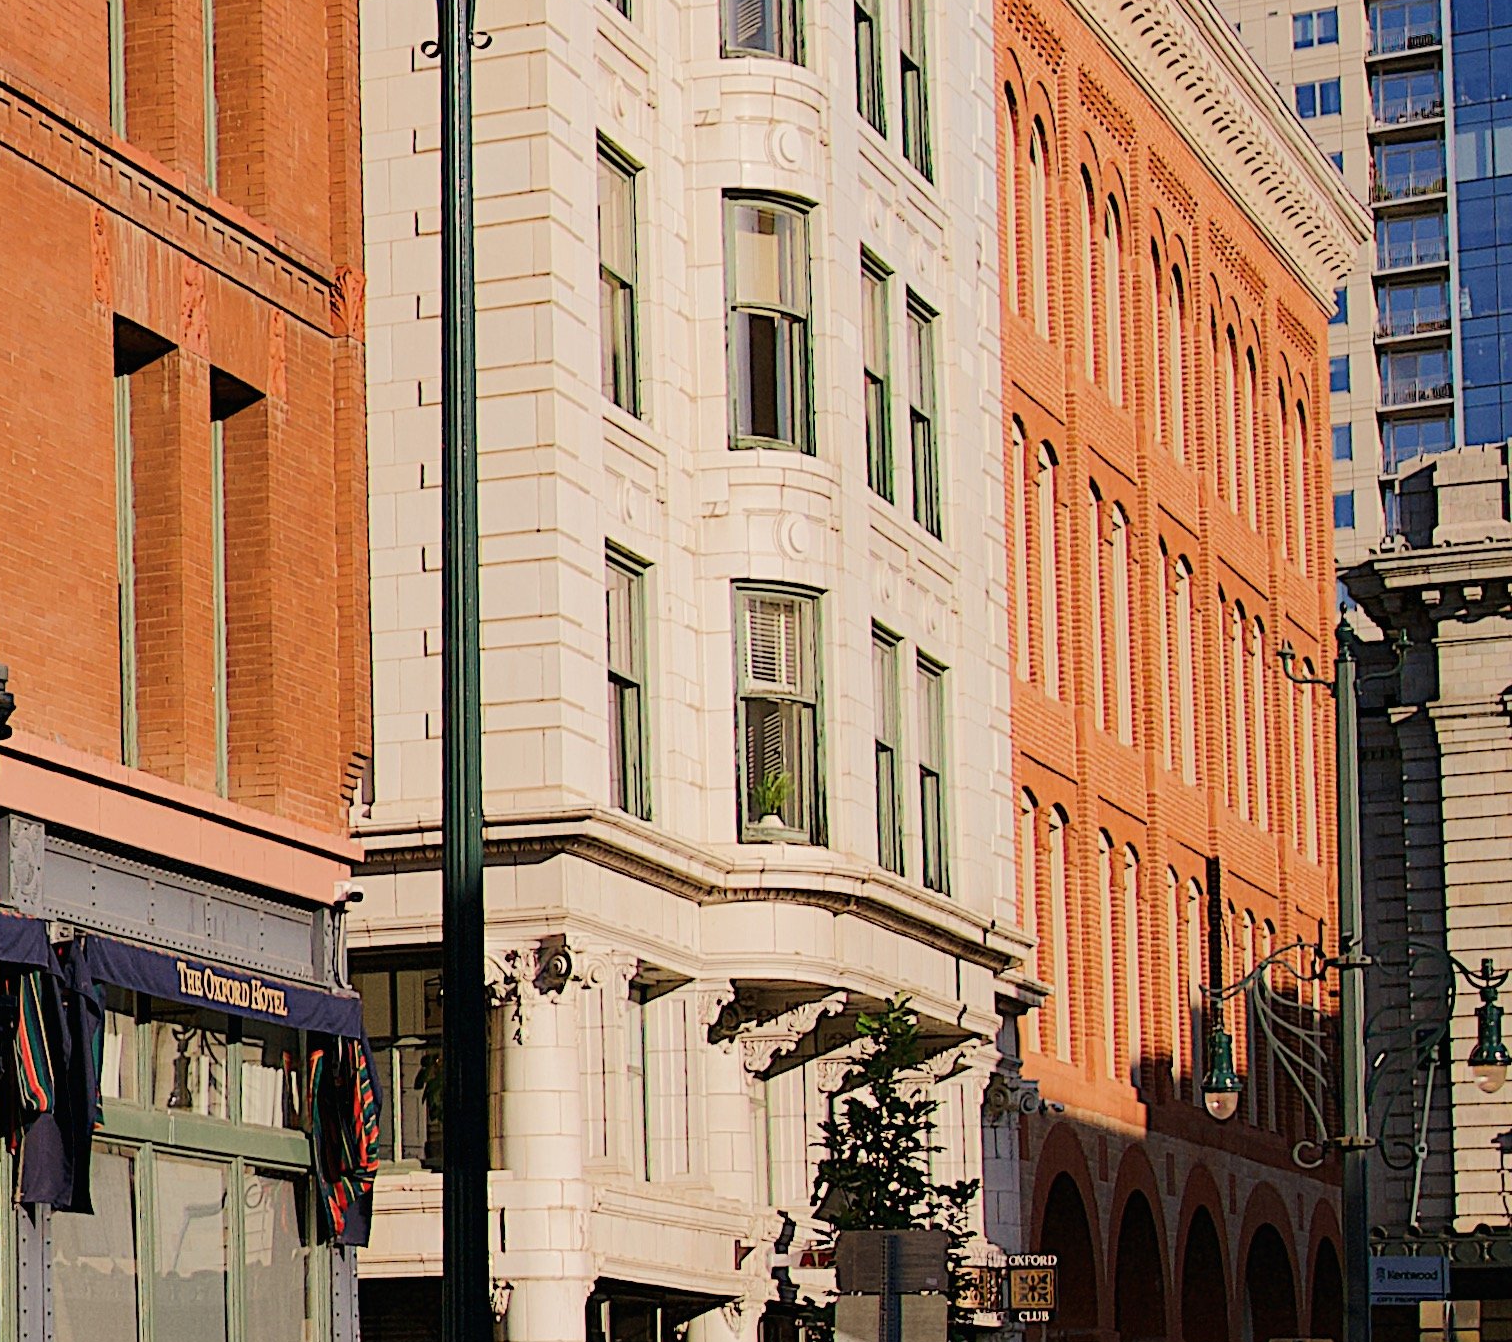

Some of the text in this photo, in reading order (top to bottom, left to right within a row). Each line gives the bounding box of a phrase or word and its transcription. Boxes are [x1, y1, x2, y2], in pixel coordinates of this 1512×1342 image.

[176, 960, 289, 1017] THE OXFORD HOTEL
[1008, 1254, 1058, 1267] OXFORD
[1387, 1269, 1439, 1281] Kentwood
[1017, 1310, 1050, 1323] CLUB
